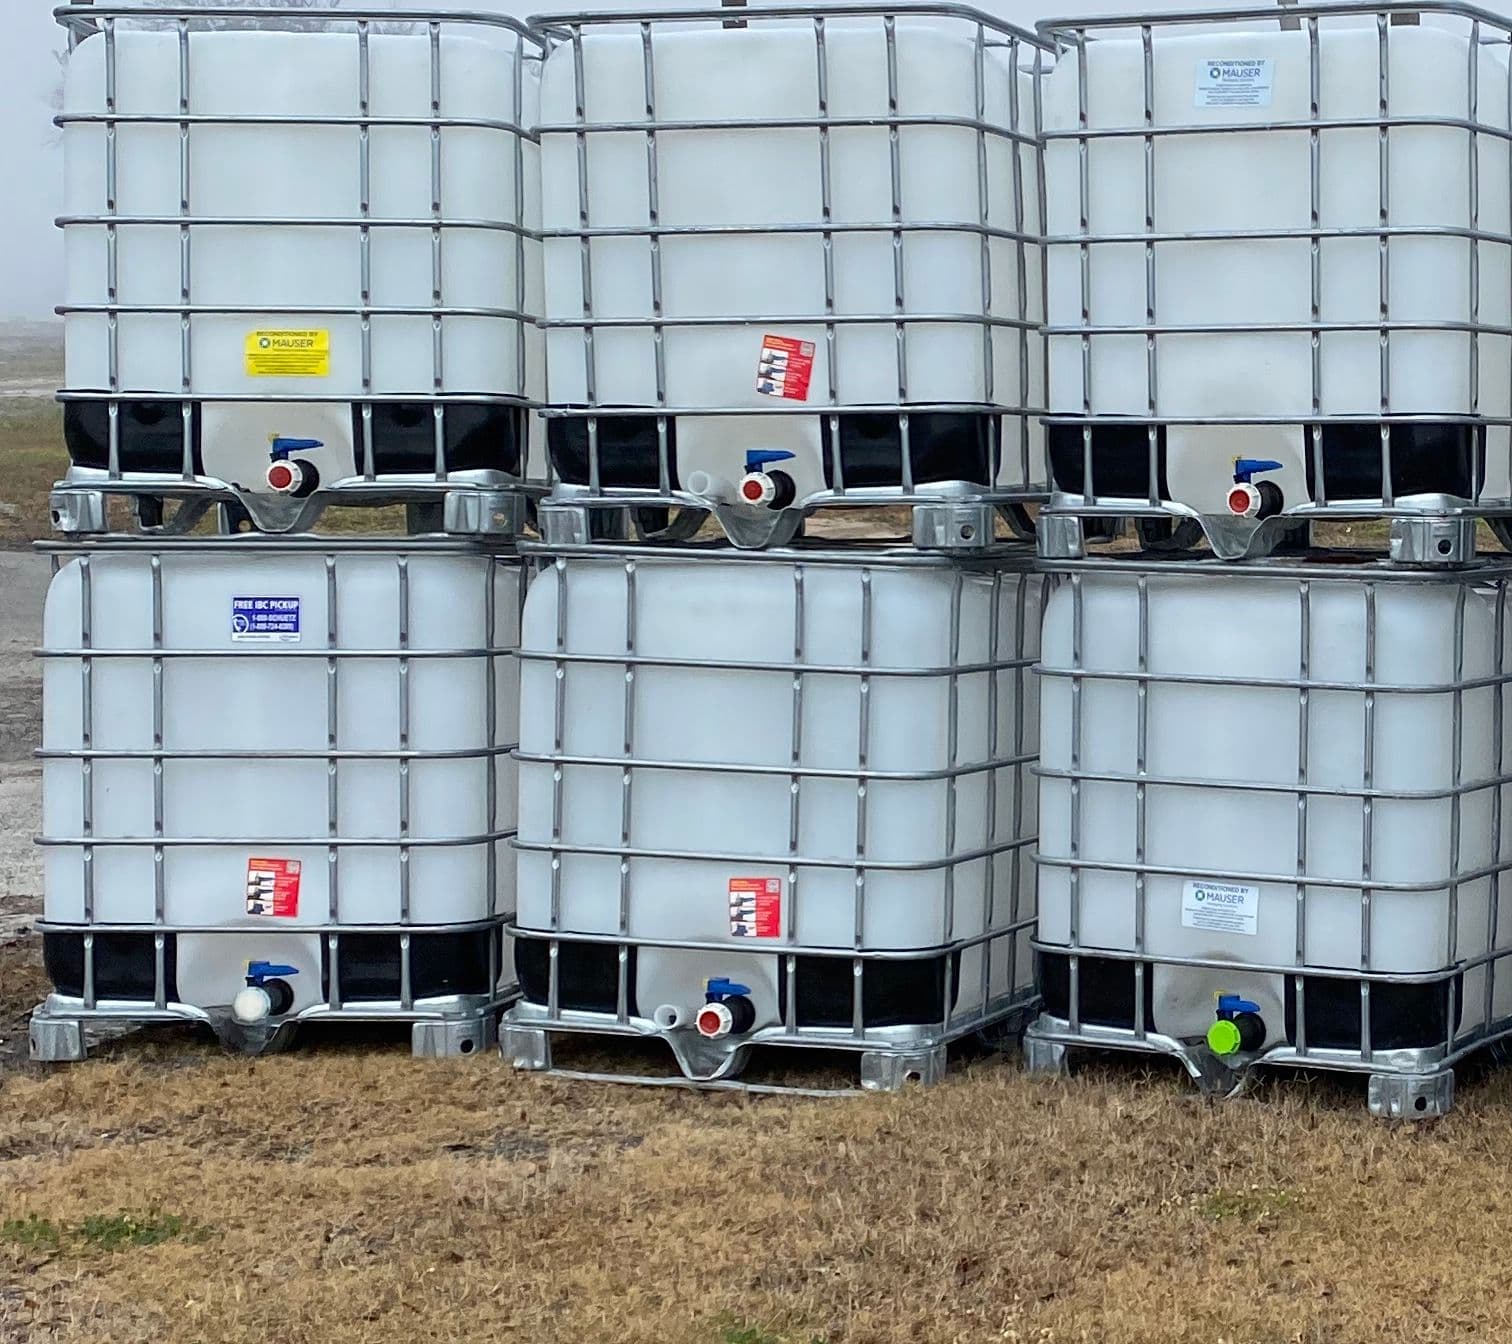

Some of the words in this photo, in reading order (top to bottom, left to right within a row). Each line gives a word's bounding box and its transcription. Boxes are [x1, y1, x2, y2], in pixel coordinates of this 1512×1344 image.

[1222, 68, 1261, 77] MAUSER
[272, 338, 314, 348] MAUSER
[233, 600, 253, 609] FREE
[254, 600, 269, 609] IBC
[269, 600, 299, 610] PICKUP
[1192, 882, 1240, 894] RECONDITIONED
[1206, 892, 1245, 904] MAUSER
